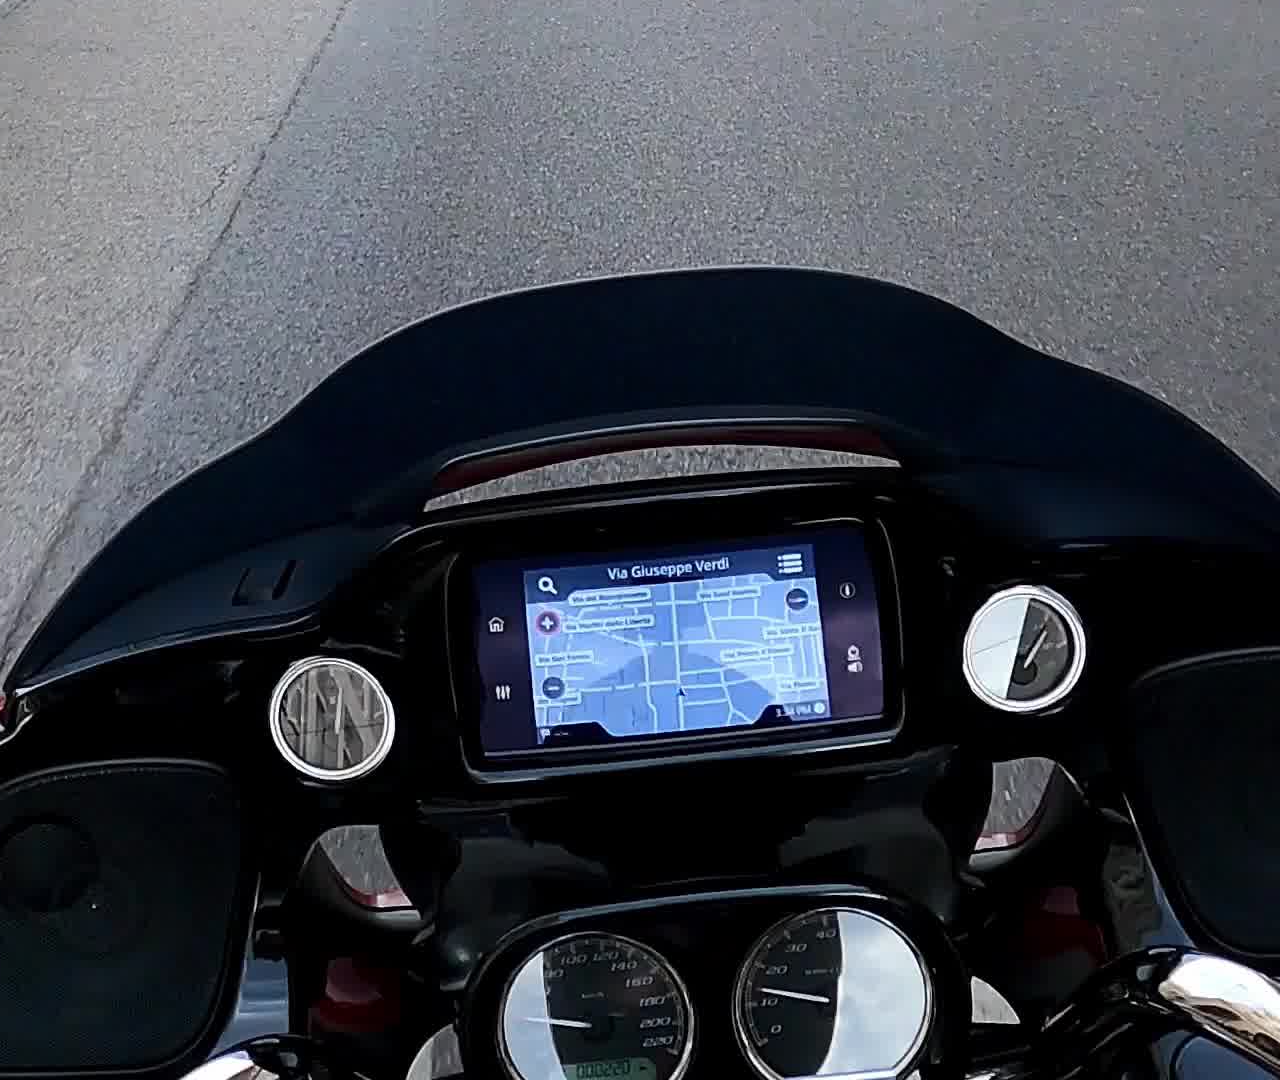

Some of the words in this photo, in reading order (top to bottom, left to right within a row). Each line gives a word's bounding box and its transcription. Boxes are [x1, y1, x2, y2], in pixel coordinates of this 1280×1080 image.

[607, 565, 627, 581] Via
[631, 561, 693, 579] Giuseppe
[695, 556, 730, 572] Verdi
[560, 954, 588, 966] 100
[610, 961, 638, 972] 140
[765, 965, 788, 975] 20
[760, 997, 779, 1008] 10
[639, 1016, 672, 1029] 200
